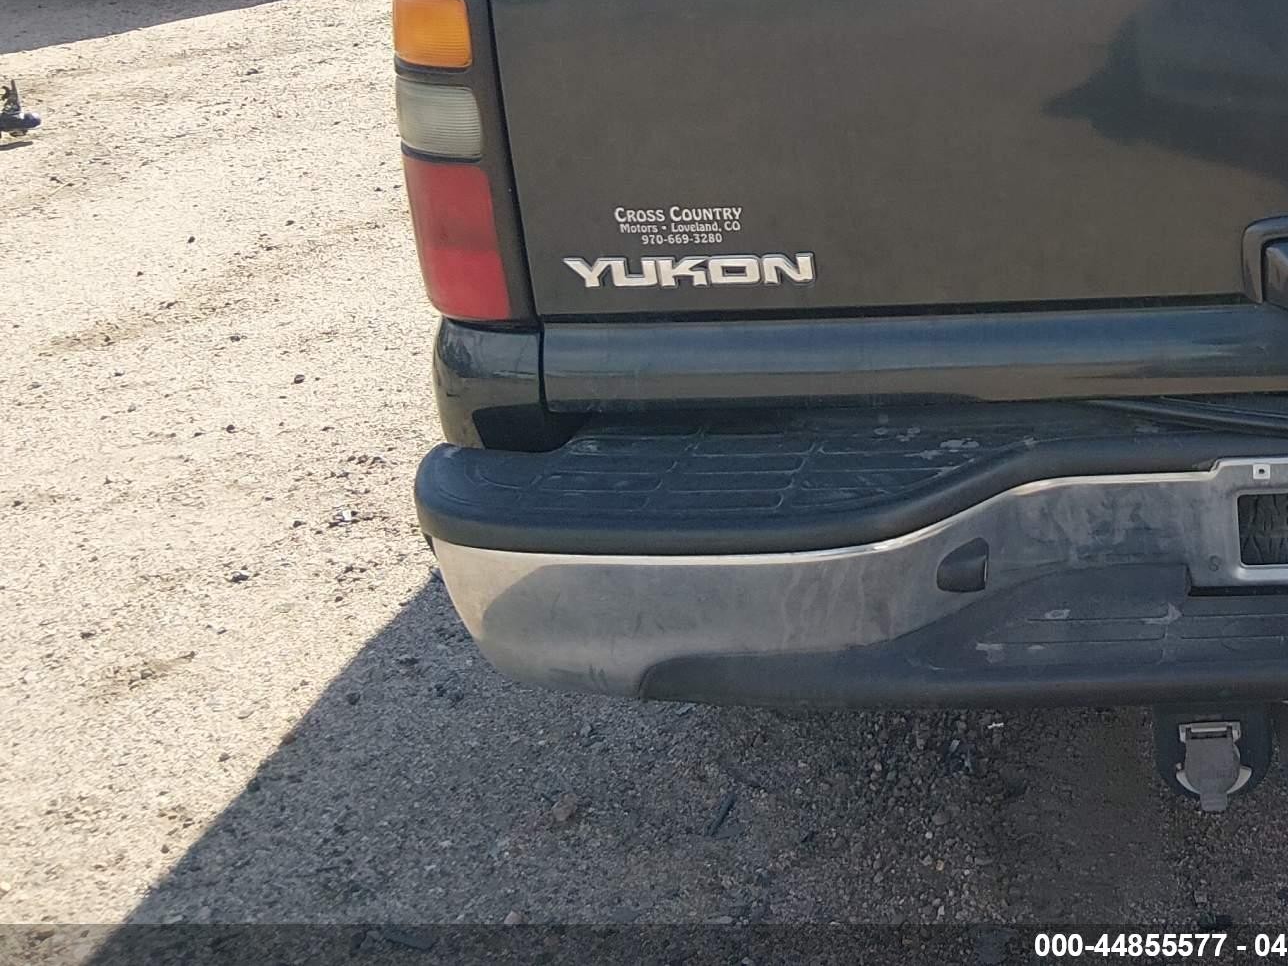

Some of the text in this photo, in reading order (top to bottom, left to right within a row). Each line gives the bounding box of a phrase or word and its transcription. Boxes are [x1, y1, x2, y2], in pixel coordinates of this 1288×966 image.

[613, 205, 742, 223] CROSS COUNTRY
[619, 223, 659, 234] Motors
[723, 220, 741, 232] CO
[641, 232, 723, 245] 970-669-3280
[562, 251, 815, 288] YUKON
